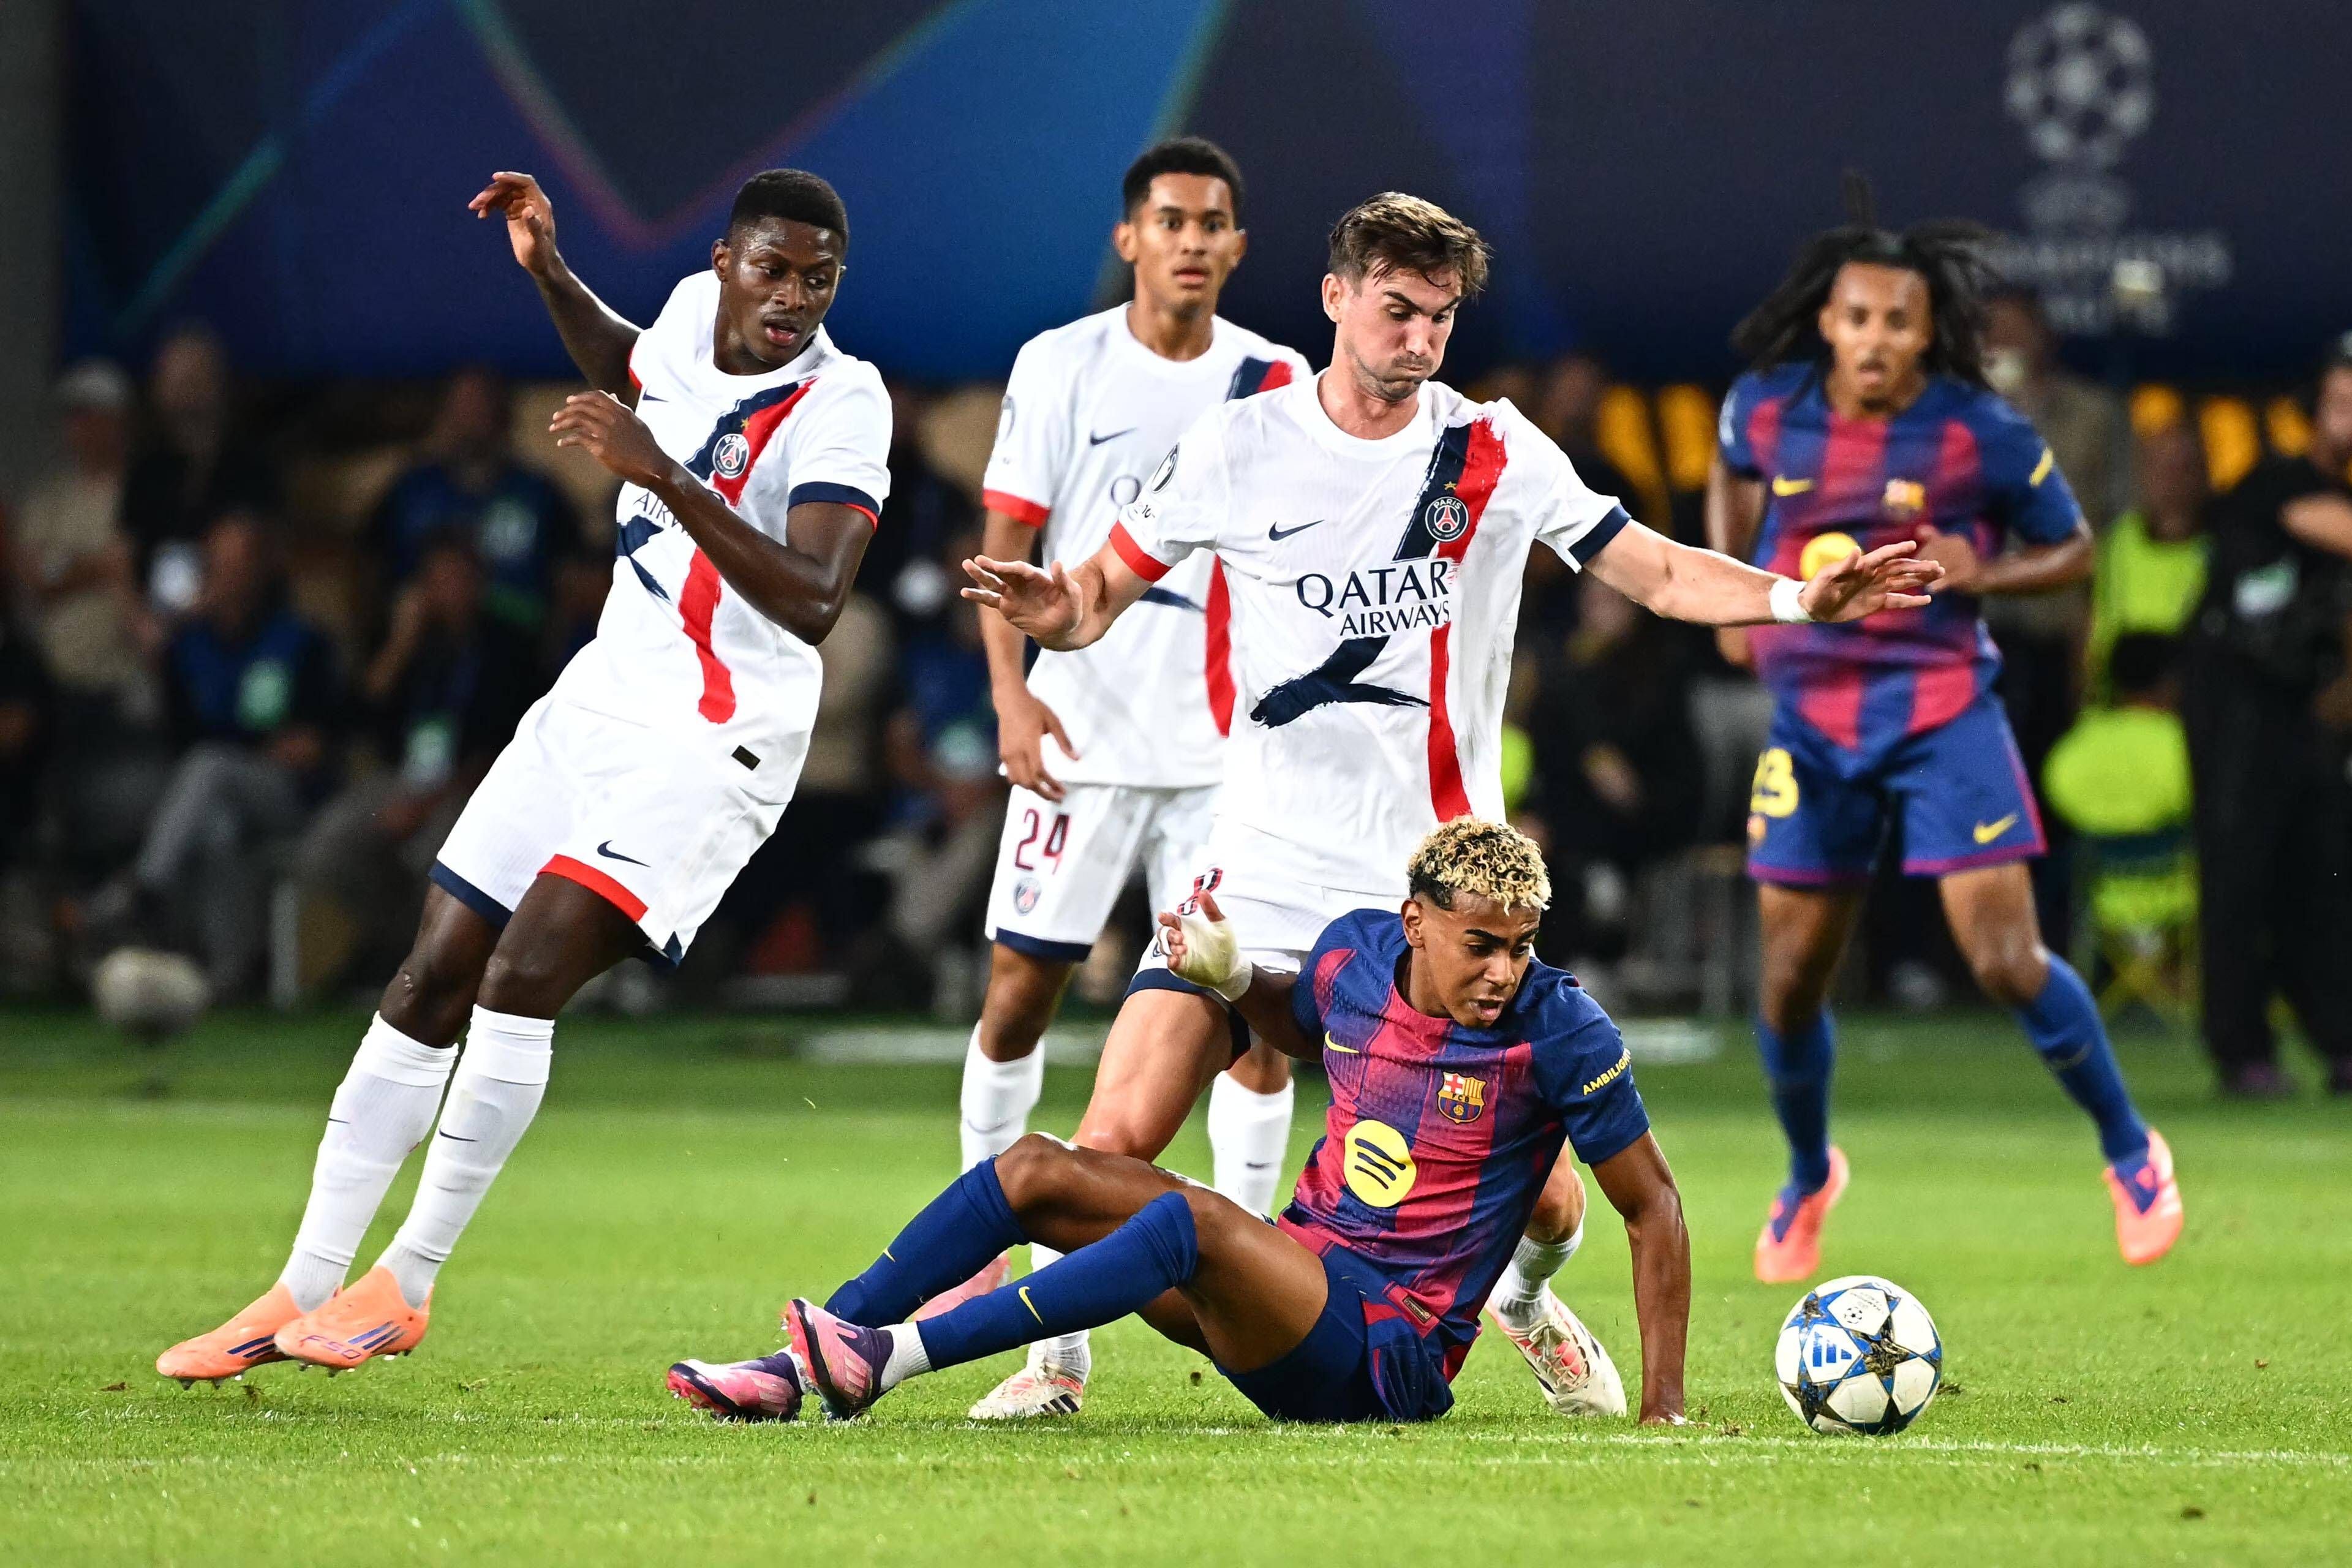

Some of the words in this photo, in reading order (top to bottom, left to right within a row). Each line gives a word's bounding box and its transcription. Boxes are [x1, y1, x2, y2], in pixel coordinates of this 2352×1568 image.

[1433, 499, 1462, 510] PARIS
[1297, 560, 1449, 619] QATAR
[1340, 600, 1450, 636] AIRWAYS
[1015, 809, 1069, 875] 24
